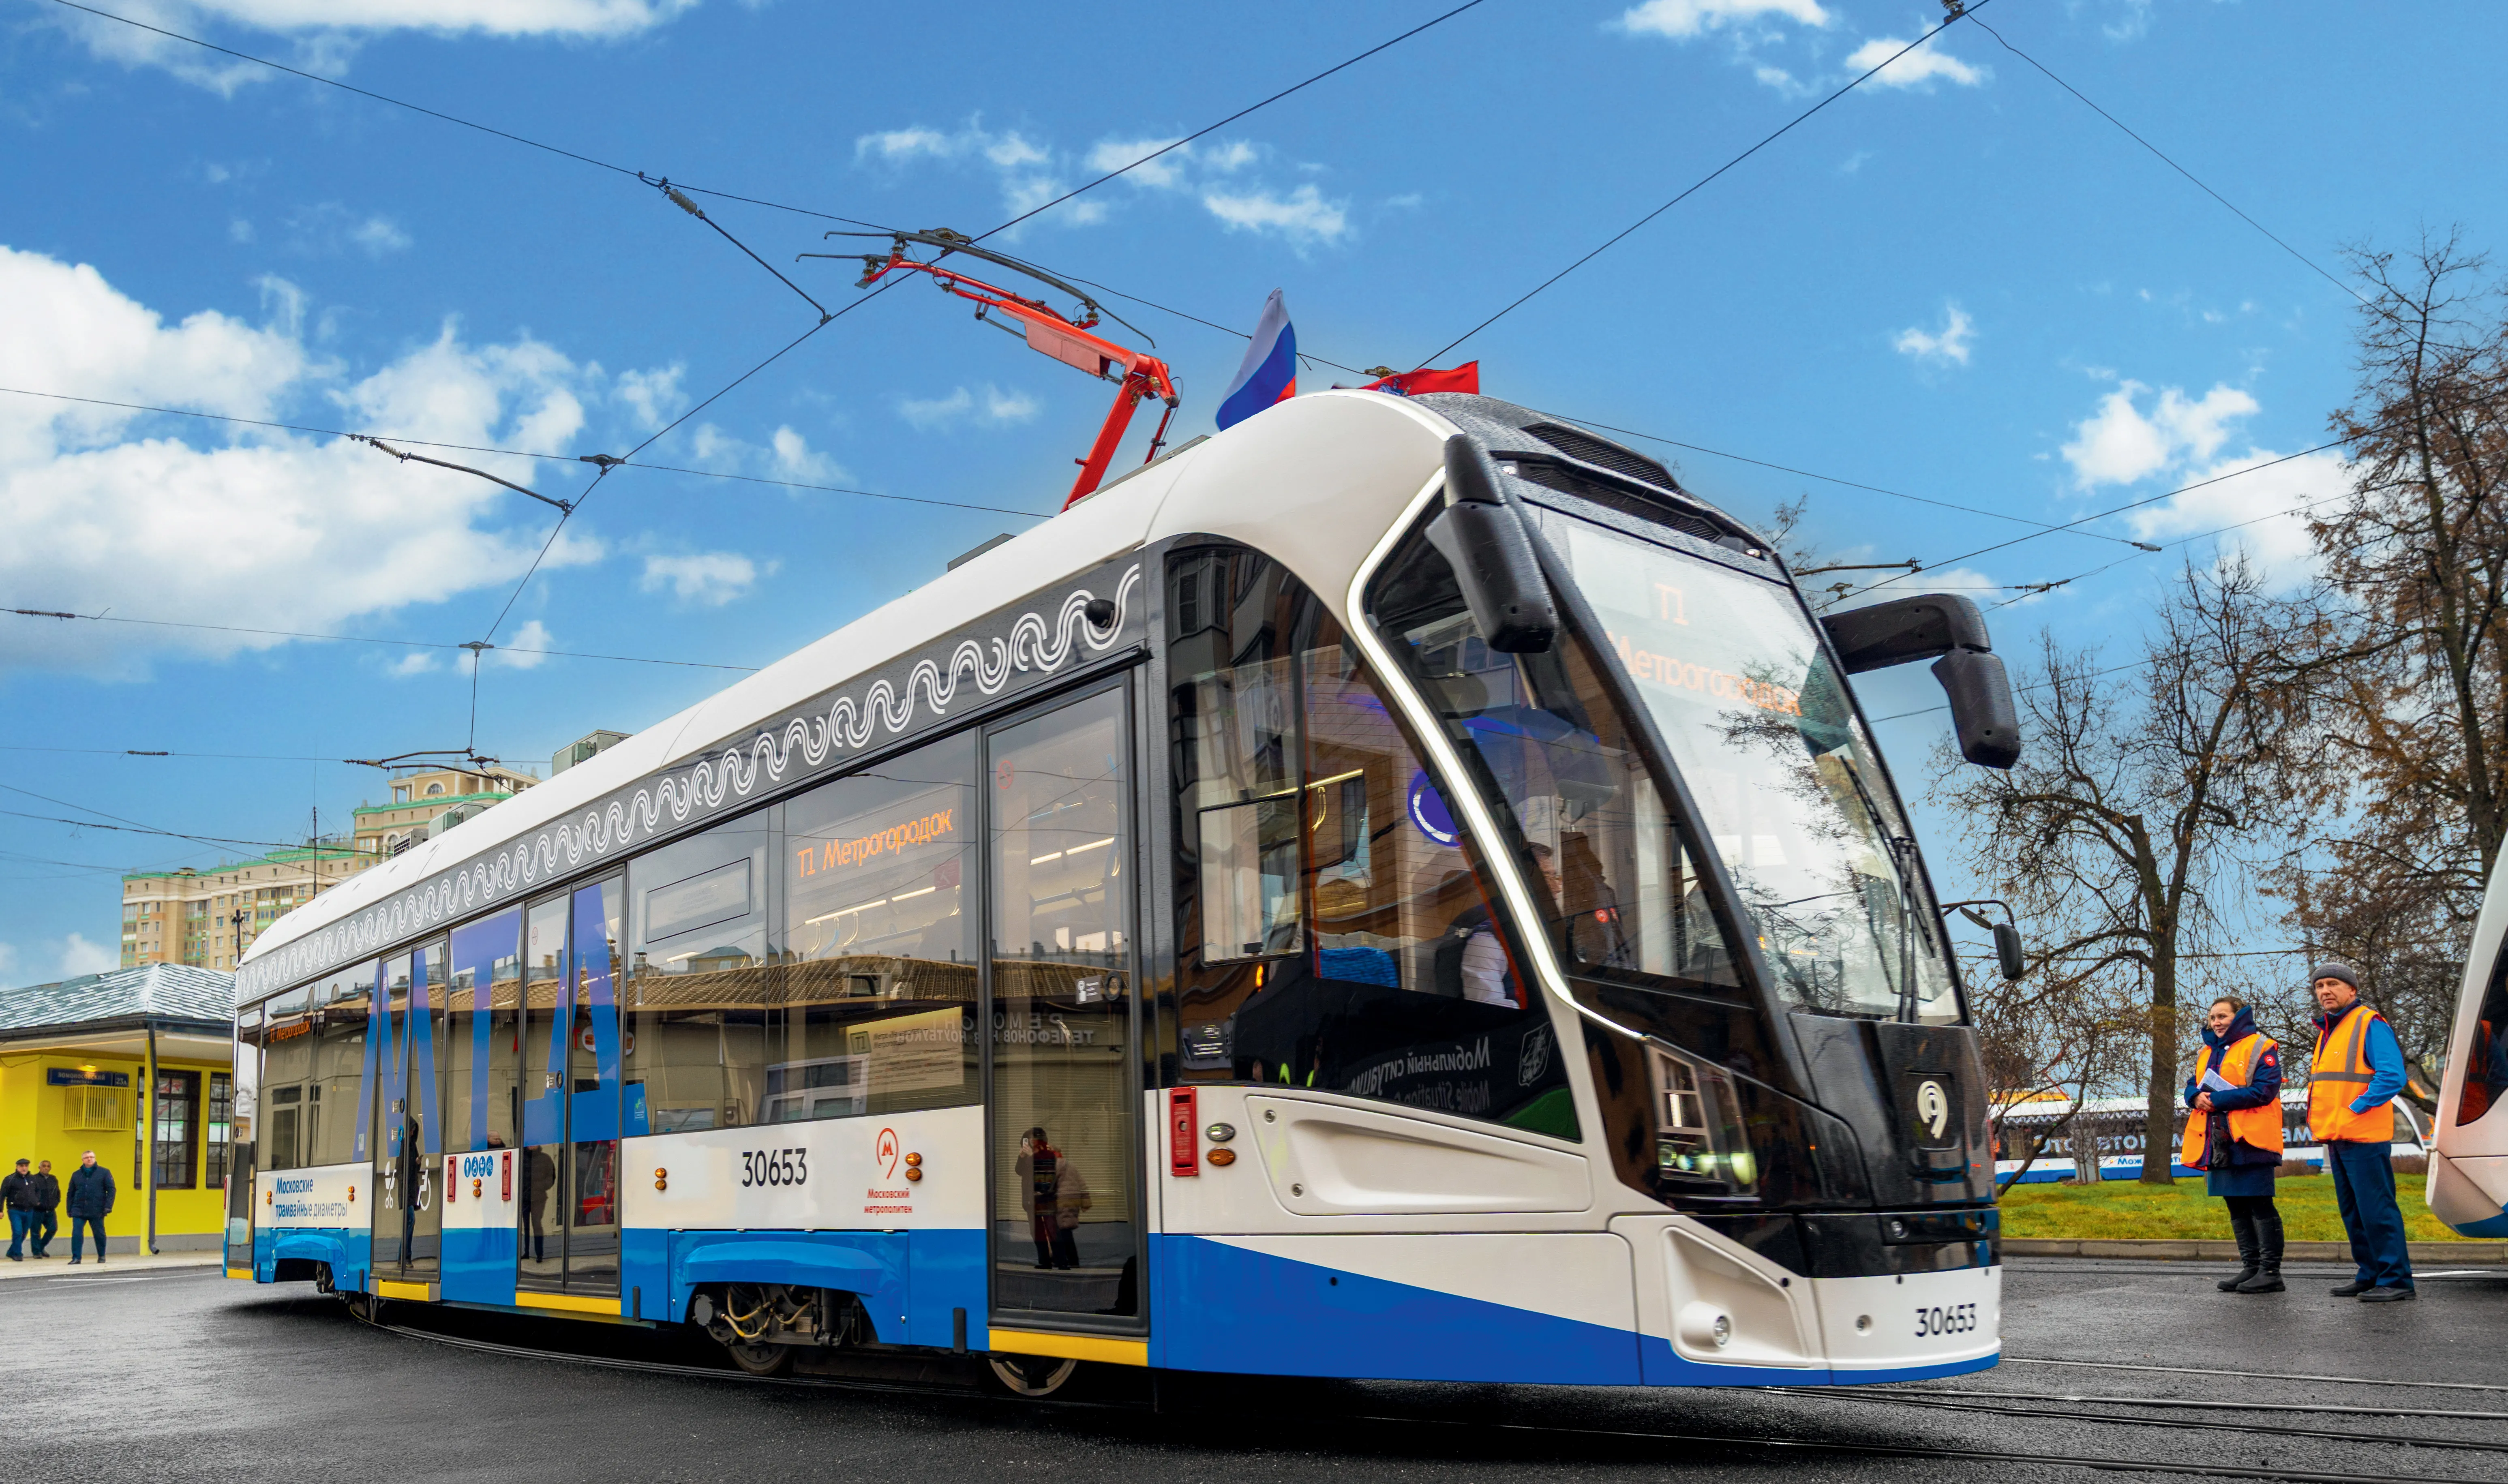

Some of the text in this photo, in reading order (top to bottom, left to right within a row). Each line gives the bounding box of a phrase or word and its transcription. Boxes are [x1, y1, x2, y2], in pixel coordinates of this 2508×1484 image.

[797, 809, 953, 878] Т1 Метрогородок
[741, 1148, 807, 1187] 30653
[276, 1177, 313, 1195] Московские
[867, 1188, 910, 1199] Московский
[275, 1200, 347, 1222] трамвайные диаметры
[863, 1206, 913, 1216] метрополитен
[1913, 1302, 1977, 1337] 30653
